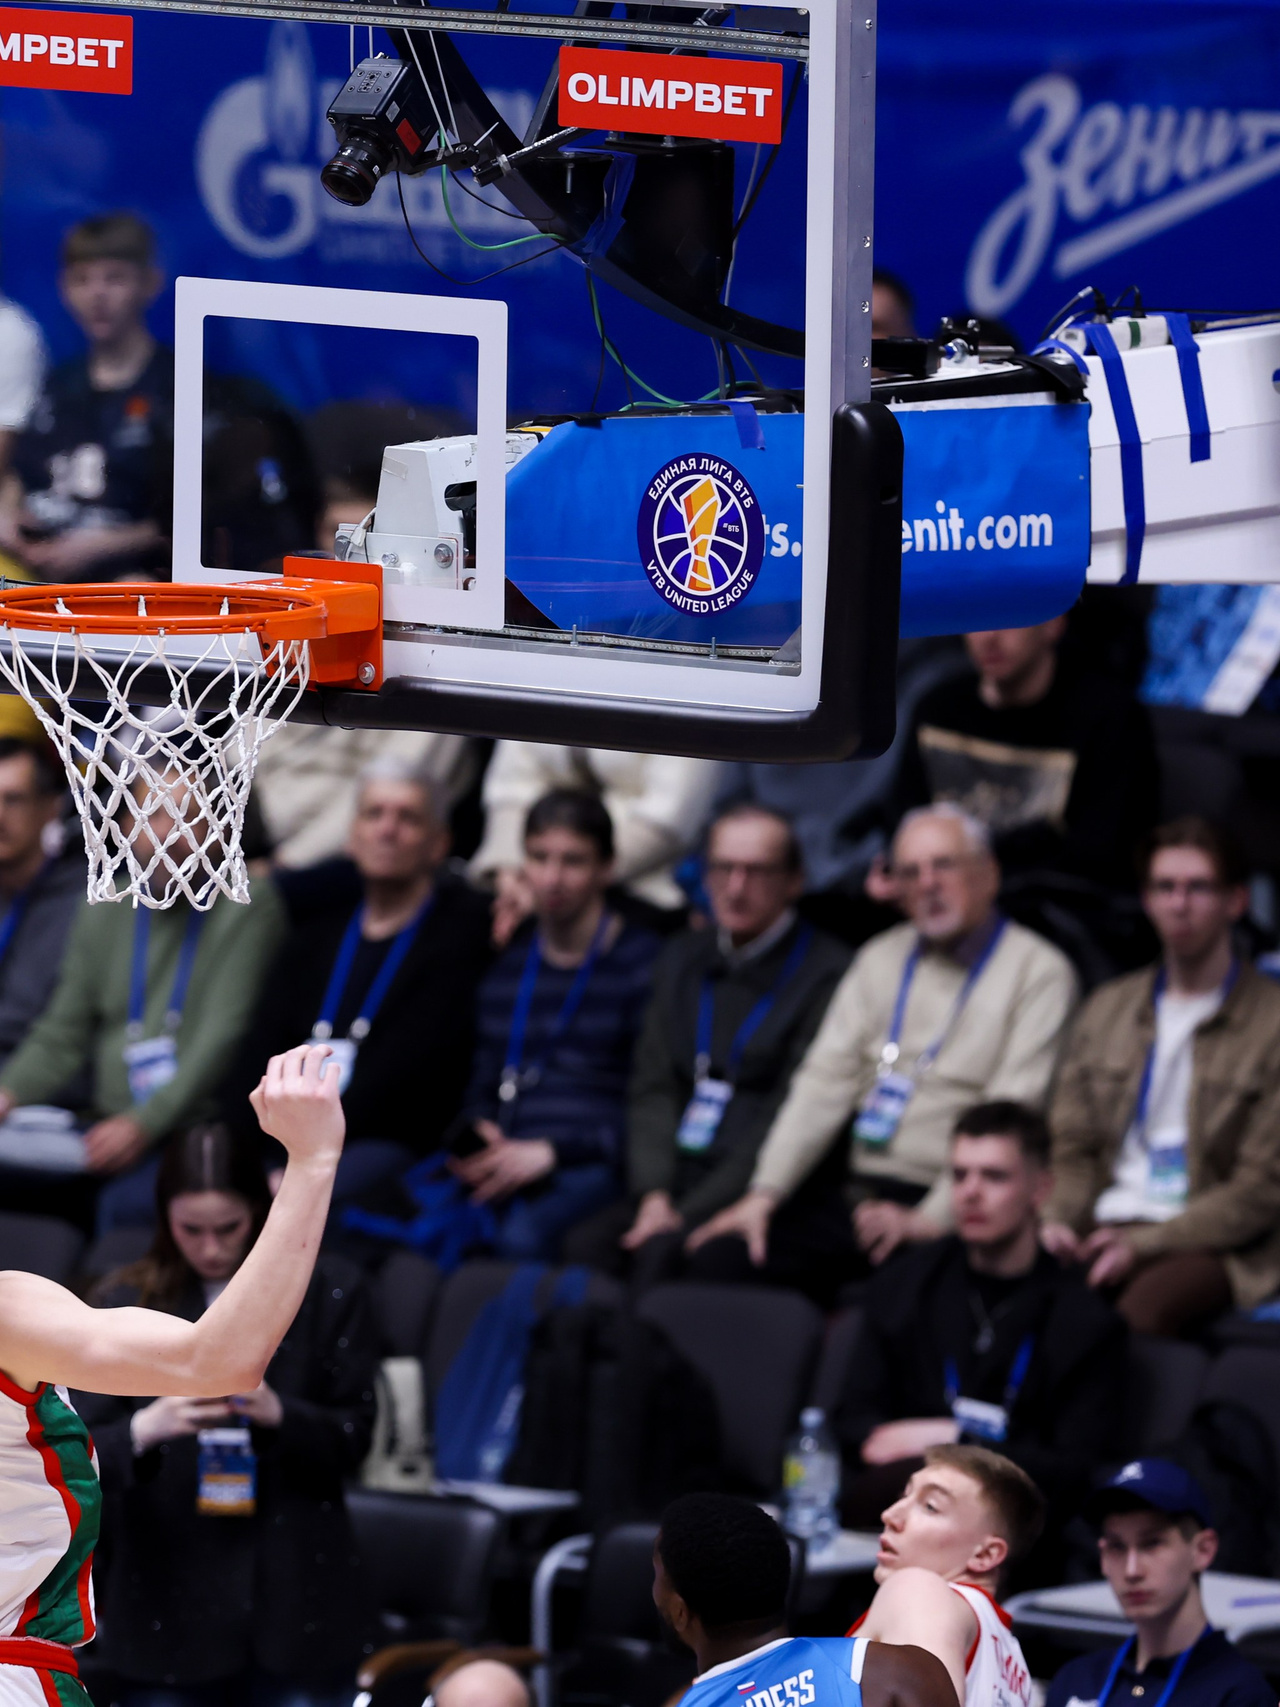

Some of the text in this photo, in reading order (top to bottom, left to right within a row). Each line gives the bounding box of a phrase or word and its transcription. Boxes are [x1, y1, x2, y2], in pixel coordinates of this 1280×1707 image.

[567, 71, 773, 118] OLIMPBET
[648, 457, 754, 509] ЕДИНАЯ ЛИГА ВТБ
[647, 559, 754, 613] VTB UNITED LEAGUE
